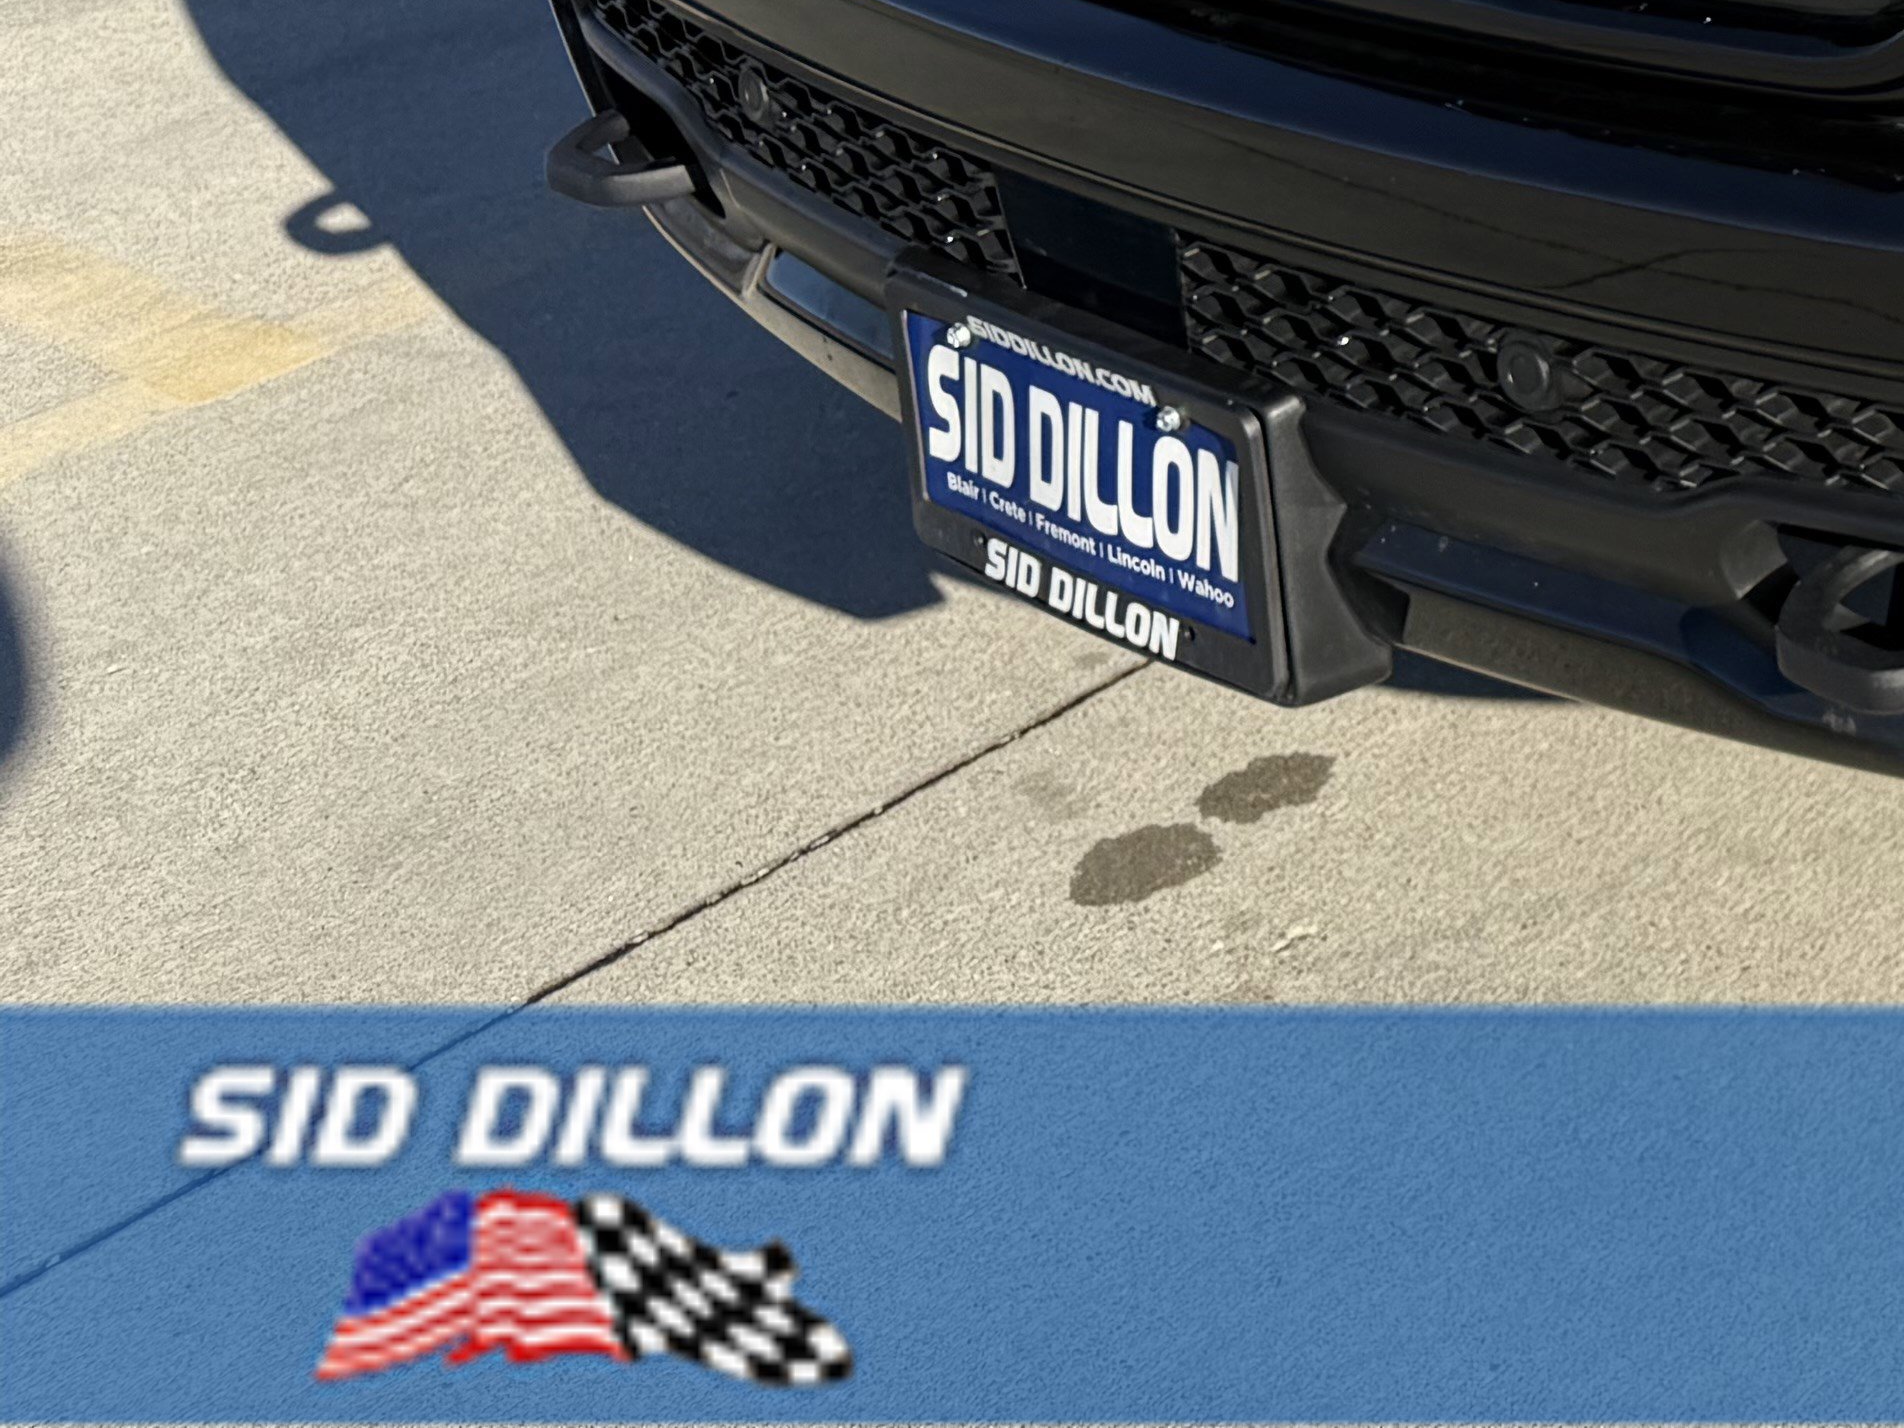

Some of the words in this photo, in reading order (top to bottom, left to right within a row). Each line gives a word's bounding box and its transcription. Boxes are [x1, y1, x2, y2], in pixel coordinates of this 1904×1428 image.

[964, 314, 1157, 407] SIDDILLON.COM
[926, 344, 1016, 490] SID
[1028, 383, 1240, 584] DILLON
[946, 470, 981, 500] Blair
[989, 492, 1028, 525] Crete
[1036, 512, 1098, 557] Fremont
[1107, 545, 1166, 583] Lincoln
[1176, 570, 1236, 610] Wahoo
[984, 537, 1043, 597] SID
[1048, 570, 1181, 662] DILLON
